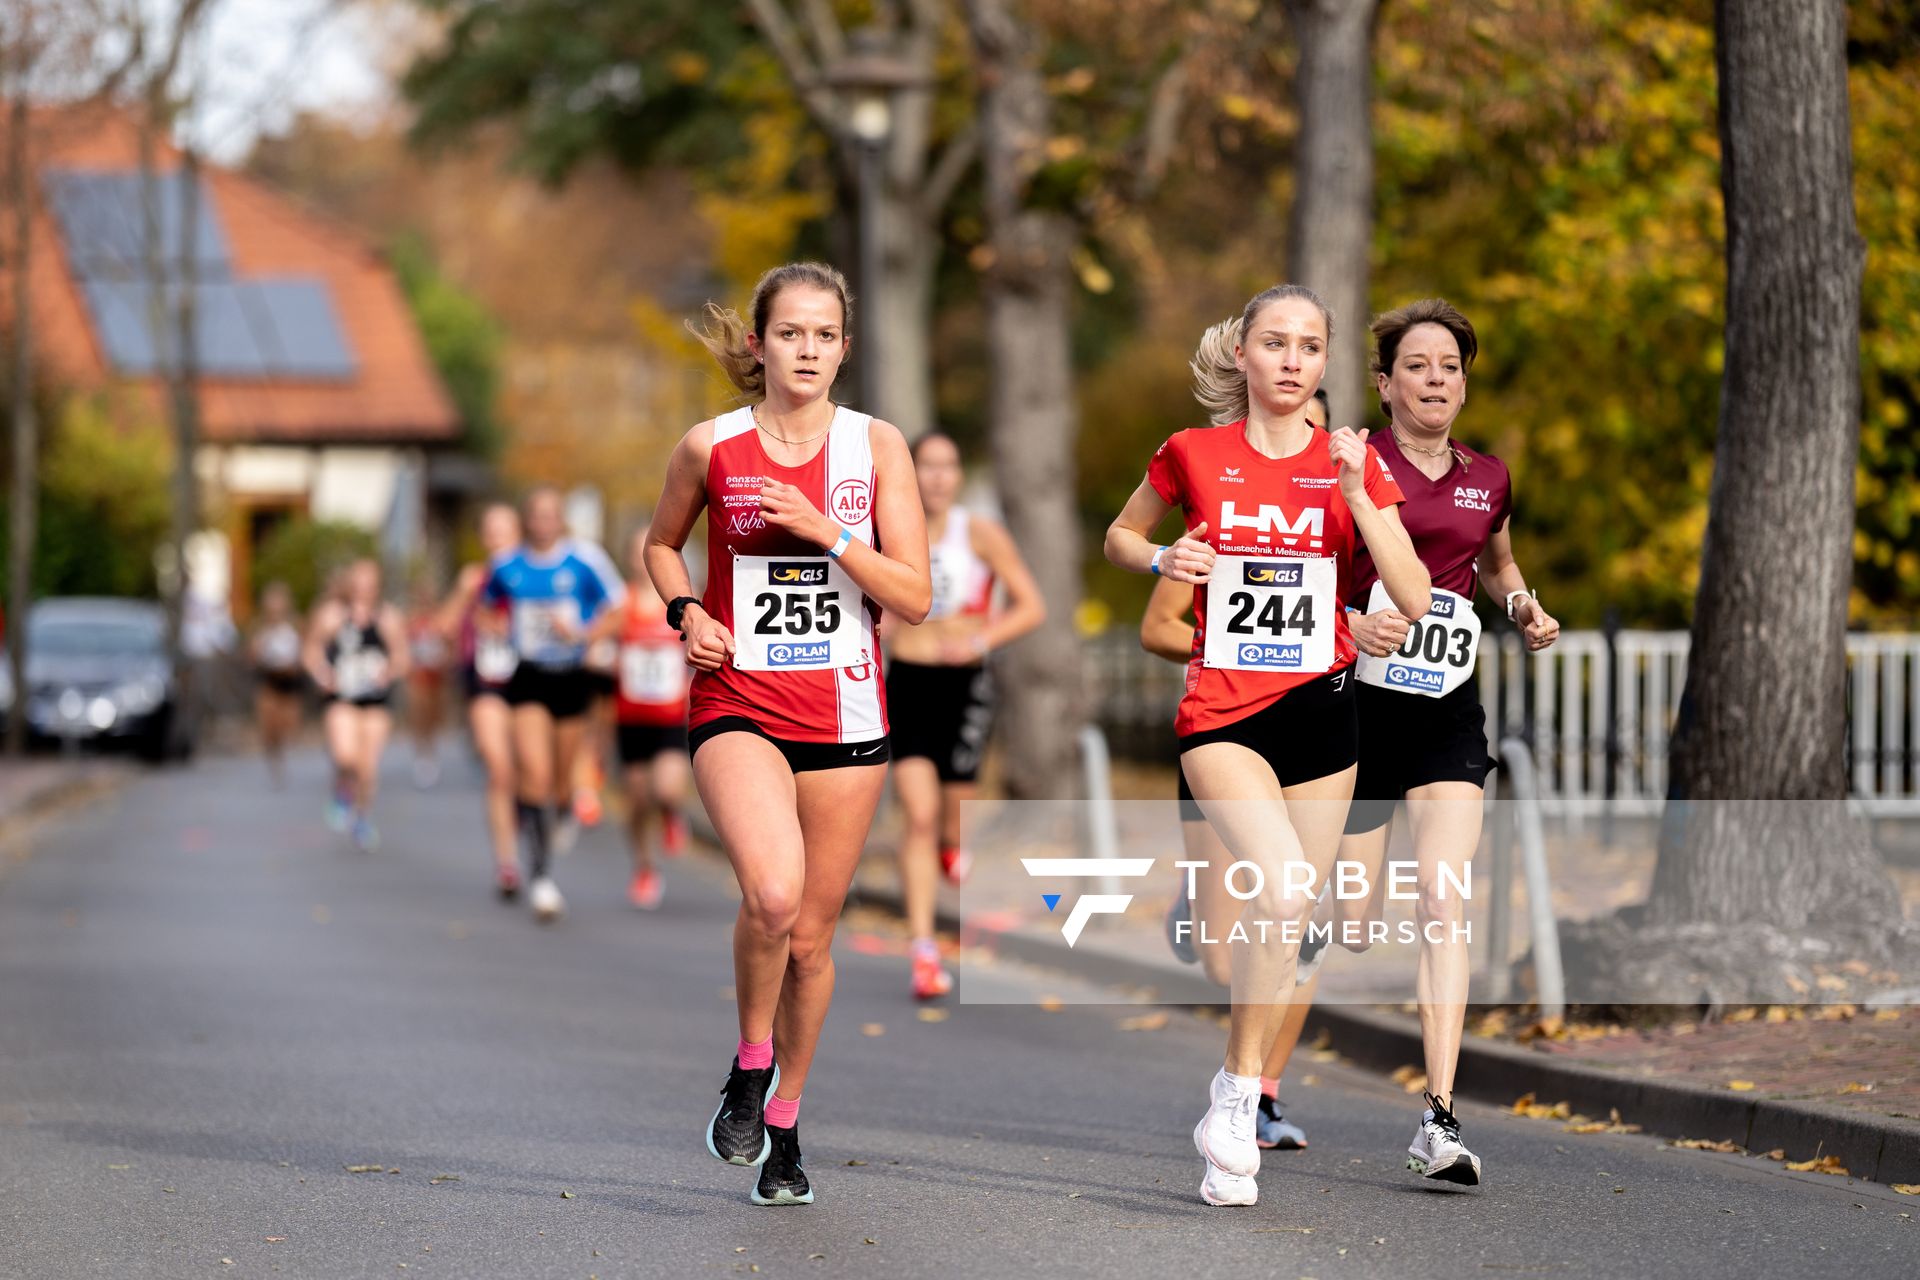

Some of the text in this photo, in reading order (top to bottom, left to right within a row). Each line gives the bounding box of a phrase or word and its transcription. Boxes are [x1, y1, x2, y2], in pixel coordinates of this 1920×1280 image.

[1454, 487, 1490, 500] ASV
[1454, 499, 1490, 512] KÖLN
[726, 511, 766, 536] Nobis
[1220, 501, 1325, 548] HM
[1219, 544, 1322, 559] Haustechnik Melsungen
[800, 569, 824, 582] GLS
[1275, 569, 1299, 583] GLS
[754, 591, 841, 635] 255
[1227, 591, 1316, 636] 244
[1430, 600, 1452, 614] GLS
[794, 645, 828, 657] PLAN
[1264, 647, 1300, 659] PLAN
[1411, 671, 1442, 685] PLAN
